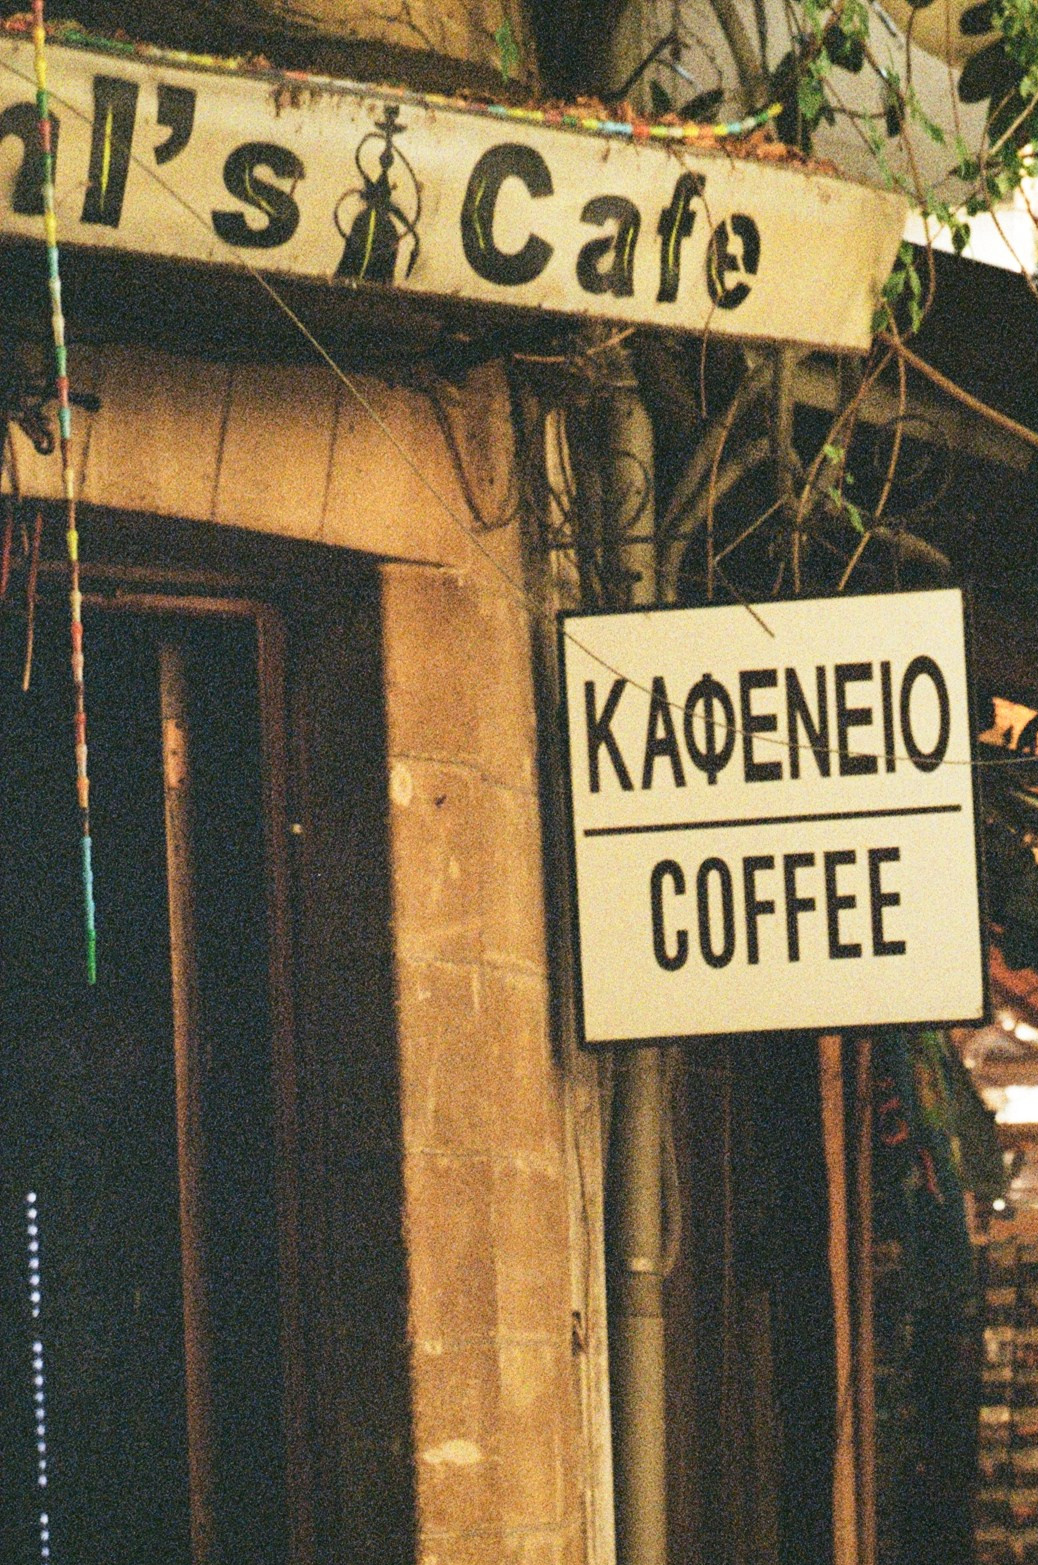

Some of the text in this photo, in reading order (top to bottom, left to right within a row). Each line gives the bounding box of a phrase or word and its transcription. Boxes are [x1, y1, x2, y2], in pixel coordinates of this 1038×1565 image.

[460, 142, 761, 311] Cafe
[583, 654, 951, 794] ΚΑΦΕΝΕΙΟ
[649, 846, 907, 972] COFFEE
